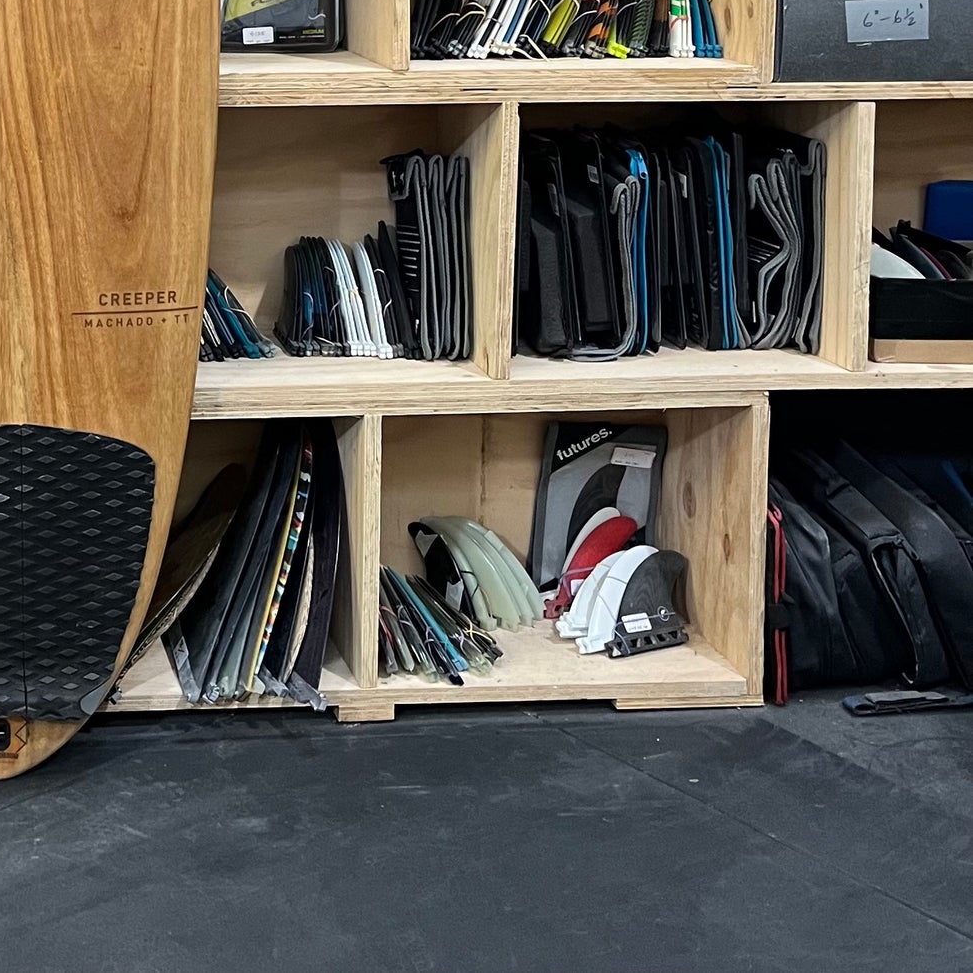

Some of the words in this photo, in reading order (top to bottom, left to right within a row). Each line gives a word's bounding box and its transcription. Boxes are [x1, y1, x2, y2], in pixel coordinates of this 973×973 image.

[98, 290, 177, 307] CREEPER
[84, 316, 154, 328] MACHADO
[174, 313, 189, 324] TT
[556, 428, 613, 461] futures.
